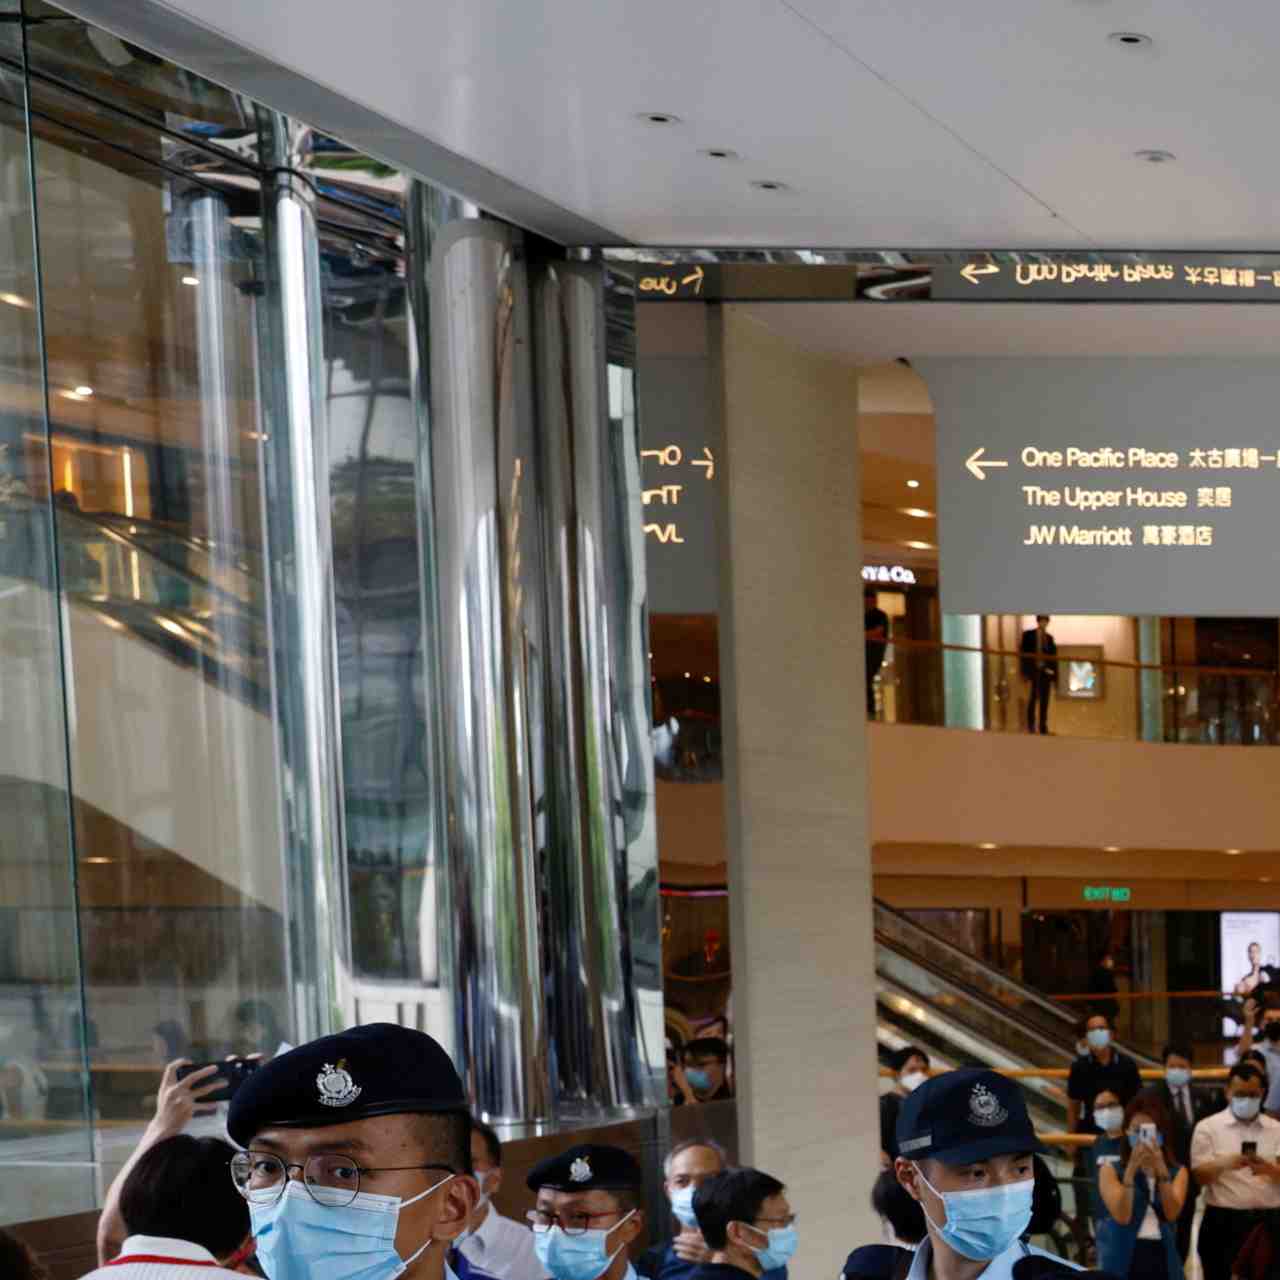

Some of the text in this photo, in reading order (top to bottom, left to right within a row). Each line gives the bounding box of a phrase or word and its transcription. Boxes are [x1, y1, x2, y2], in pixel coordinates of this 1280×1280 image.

[1021, 446, 1063, 468] One
[1066, 446, 1125, 468] Pacific
[1127, 446, 1179, 469] Place
[1021, 485, 1061, 507] The
[1064, 486, 1124, 511] Upper
[1125, 486, 1188, 508] House
[1023, 524, 1213, 546] JW Marriott 萬豪酒店
